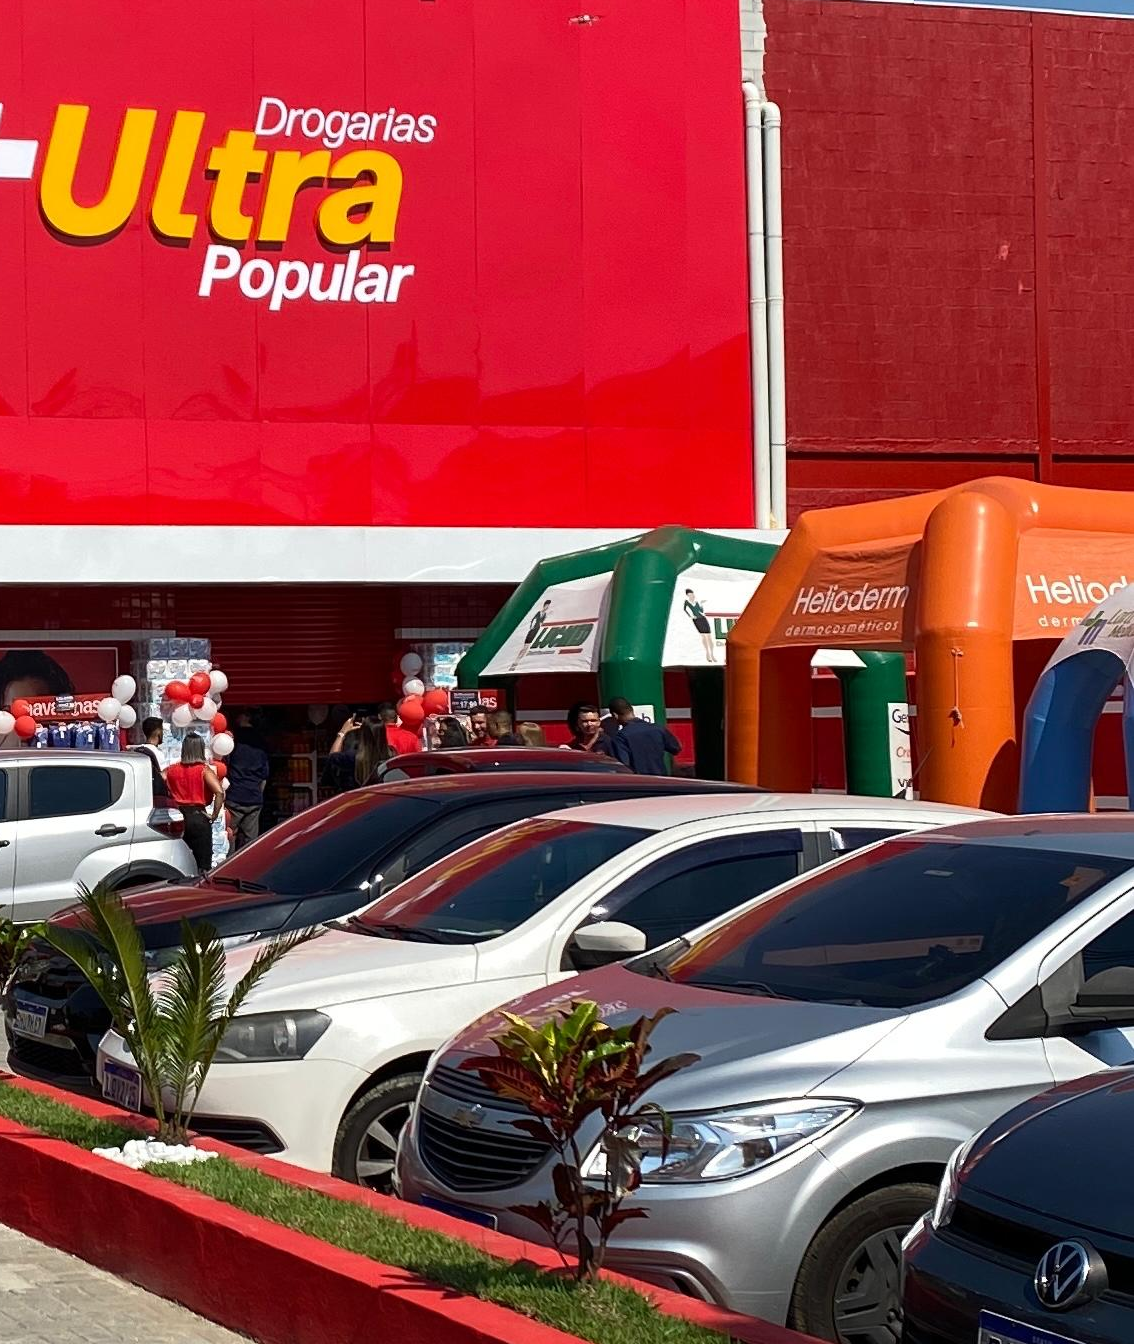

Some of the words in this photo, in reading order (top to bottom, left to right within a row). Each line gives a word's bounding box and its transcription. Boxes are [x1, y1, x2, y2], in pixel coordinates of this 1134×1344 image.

[255, 96, 437, 149] Drogarias
[39, 103, 403, 246] Ultra
[198, 244, 415, 311] Popular
[792, 582, 909, 615] Helioderm
[1026, 574, 1127, 604] Heliod
[785, 620, 898, 637] dermocosméticos
